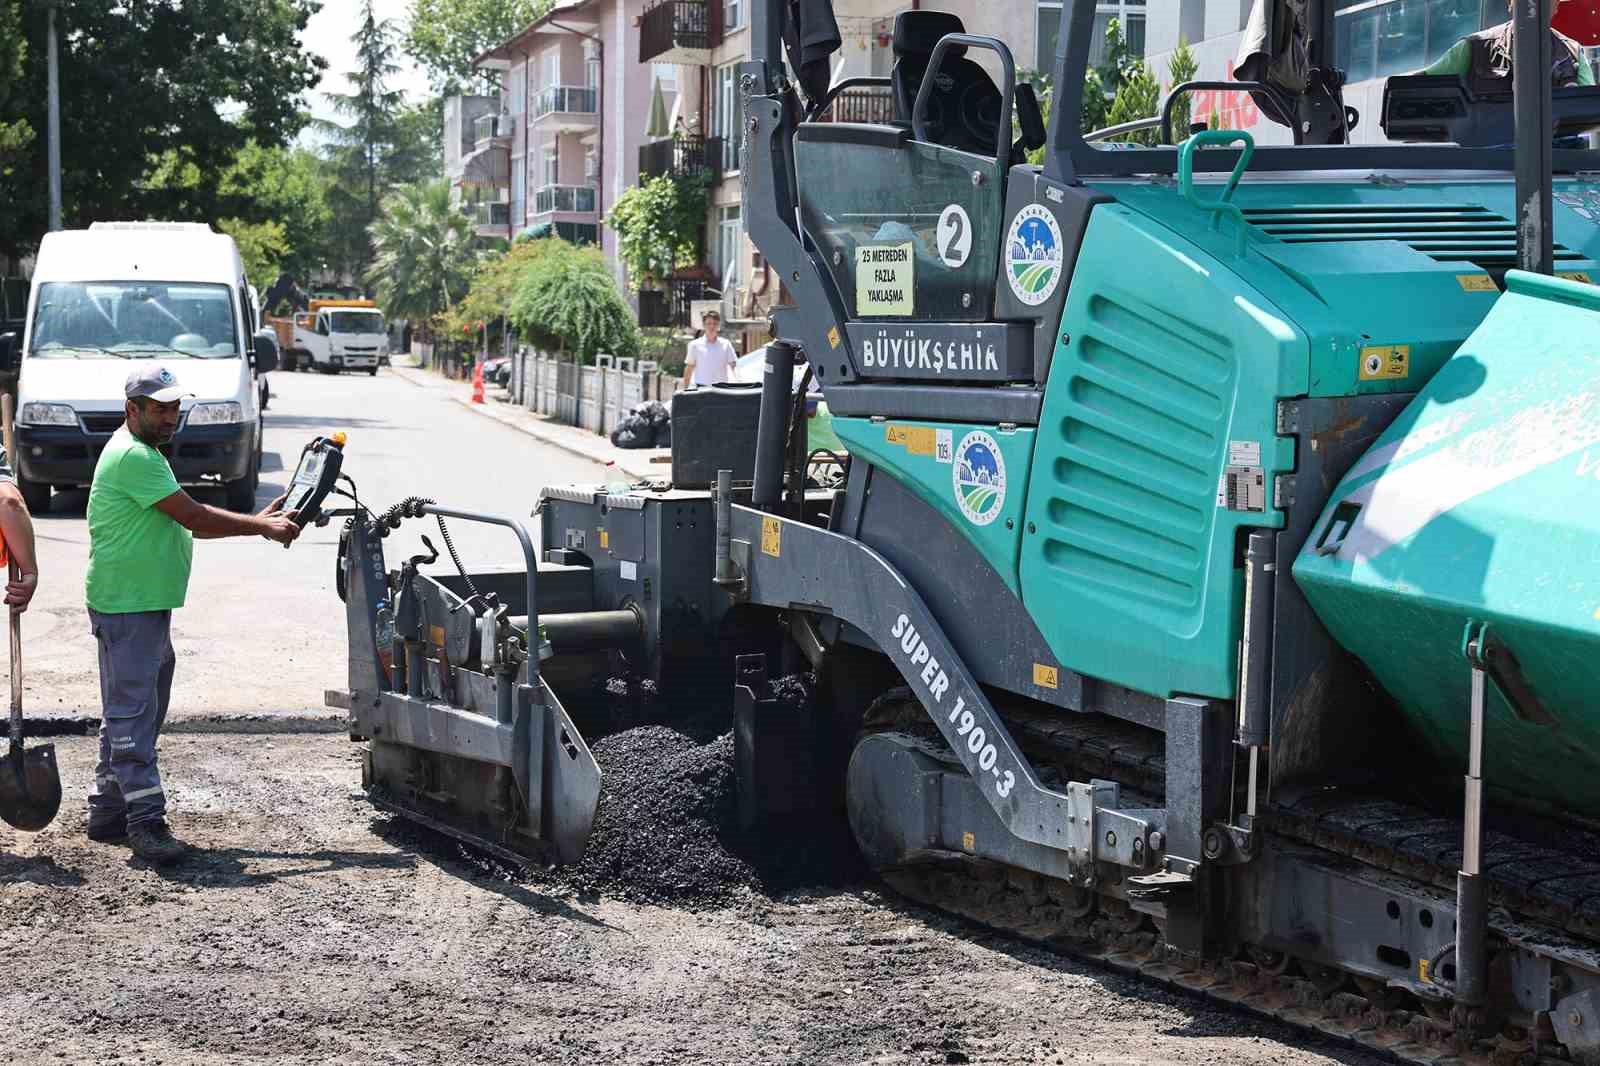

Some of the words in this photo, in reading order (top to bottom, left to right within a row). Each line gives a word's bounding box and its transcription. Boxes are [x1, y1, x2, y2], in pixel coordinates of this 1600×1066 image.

[945, 212, 963, 261] 2
[862, 250, 870, 263] 25
[872, 249, 907, 262] METREDEN
[874, 269, 896, 282] FAZLA
[867, 289, 903, 306] YAKLAŞMA
[891, 613, 950, 703] SUPER
[949, 696, 1016, 798] 1900-3
